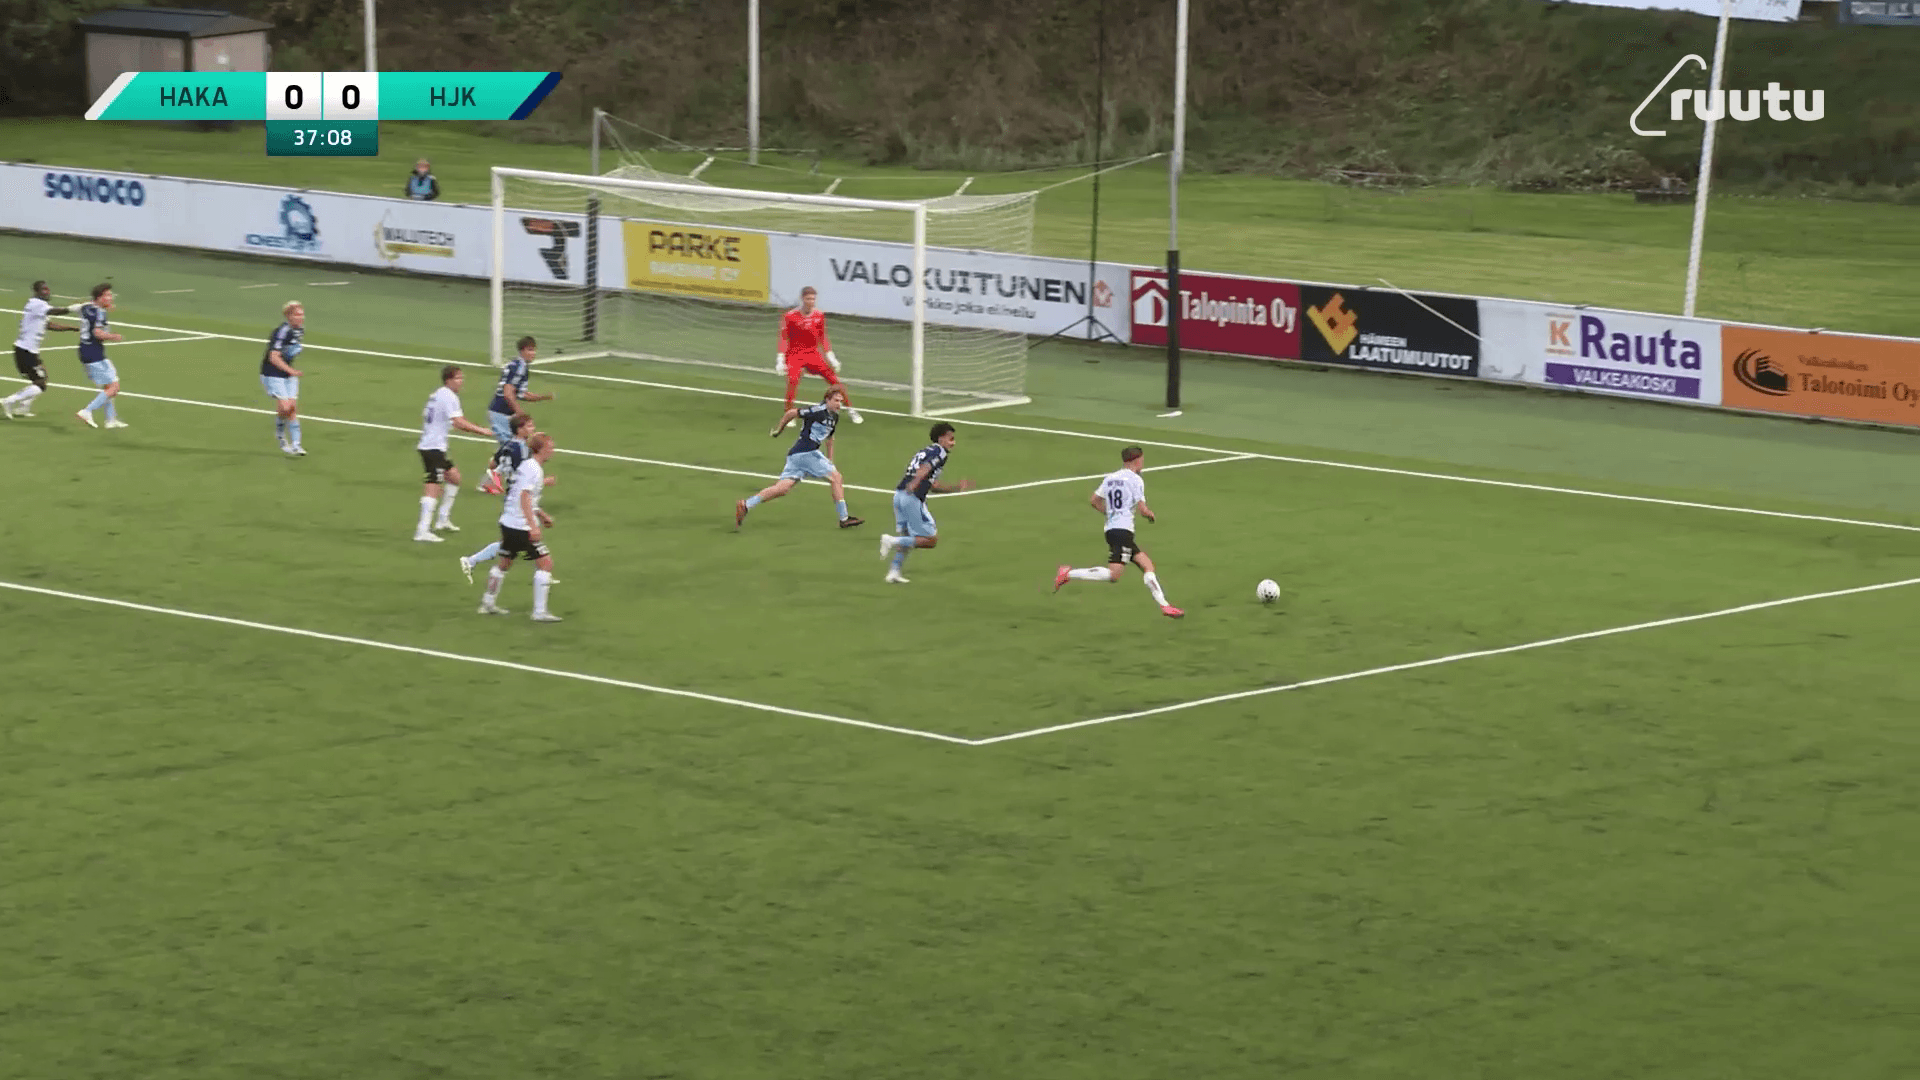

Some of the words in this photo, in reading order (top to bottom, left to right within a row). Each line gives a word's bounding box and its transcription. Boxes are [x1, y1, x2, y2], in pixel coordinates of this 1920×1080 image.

[43, 172, 146, 207] SONOCO
[648, 230, 741, 262] PARKE
[829, 257, 1087, 305] VALOKUITUNEN
[1179, 290, 1267, 327] Talopinta
[1270, 297, 1297, 333] Oy
[1348, 344, 1473, 371] LAATUMUUTOT
[1550, 320, 1571, 347] K
[1580, 315, 1701, 370] Rauta
[1572, 367, 1677, 393] VALKEAKOSKI
[1797, 373, 1887, 400] Talotoimi
[1892, 381, 1920, 408] Oy
[1107, 488, 1123, 510] 18
